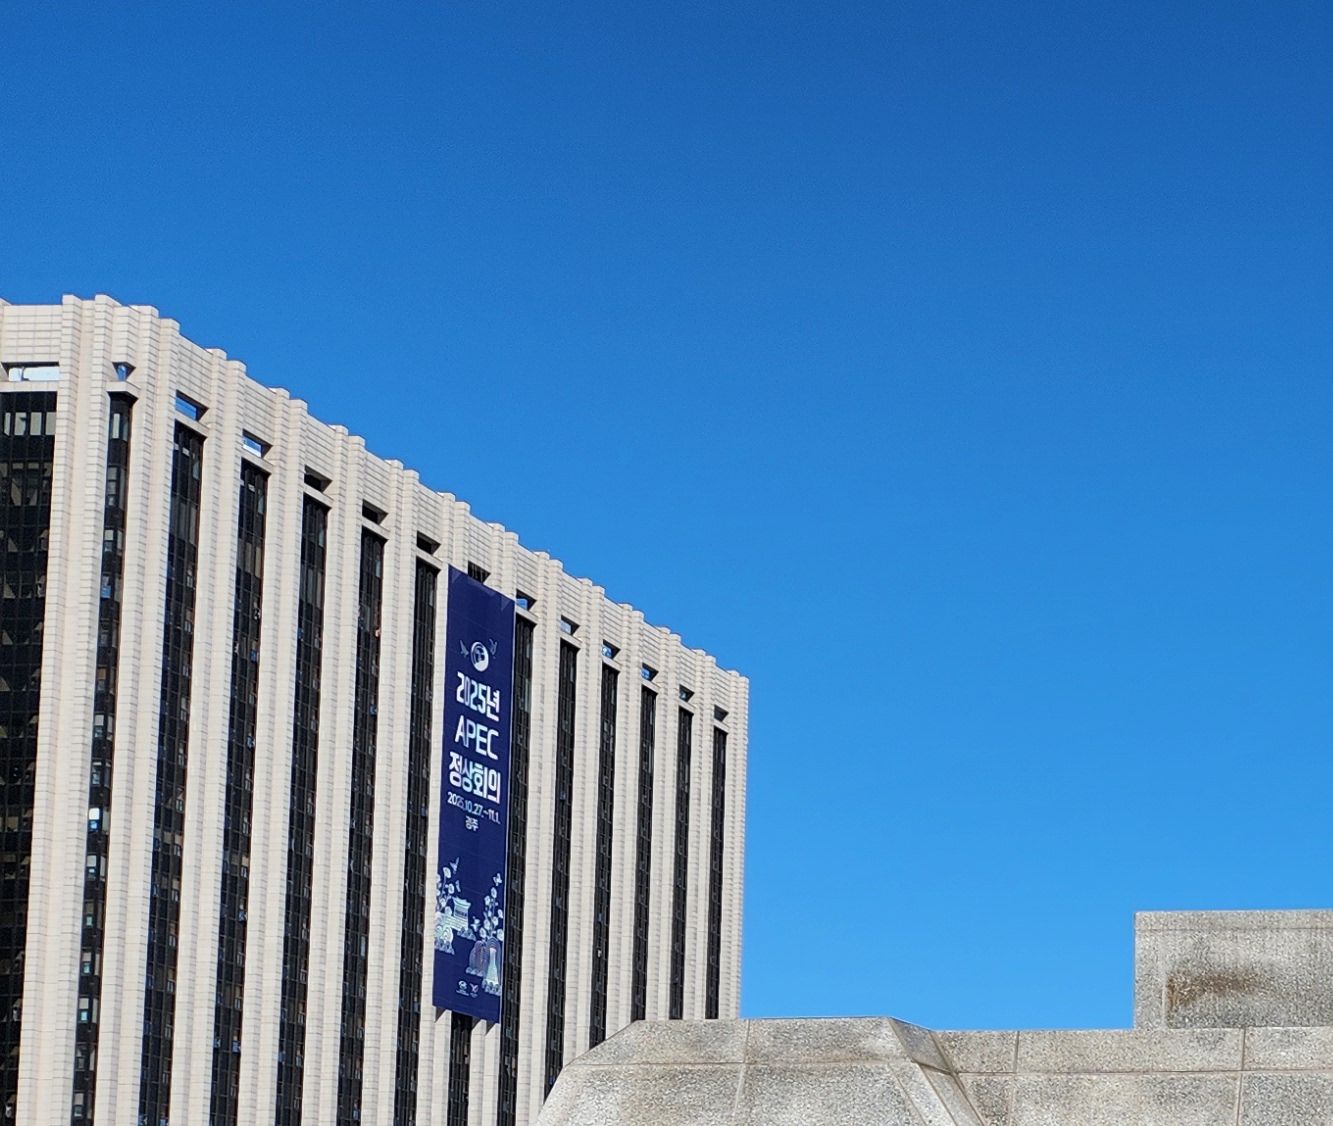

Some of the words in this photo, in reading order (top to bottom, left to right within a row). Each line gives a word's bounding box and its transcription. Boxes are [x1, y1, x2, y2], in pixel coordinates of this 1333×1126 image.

[456, 671, 501, 722] 2025년
[455, 715, 499, 760] APEC
[449, 751, 501, 804] 정상회의
[465, 815, 479, 831] 경주
